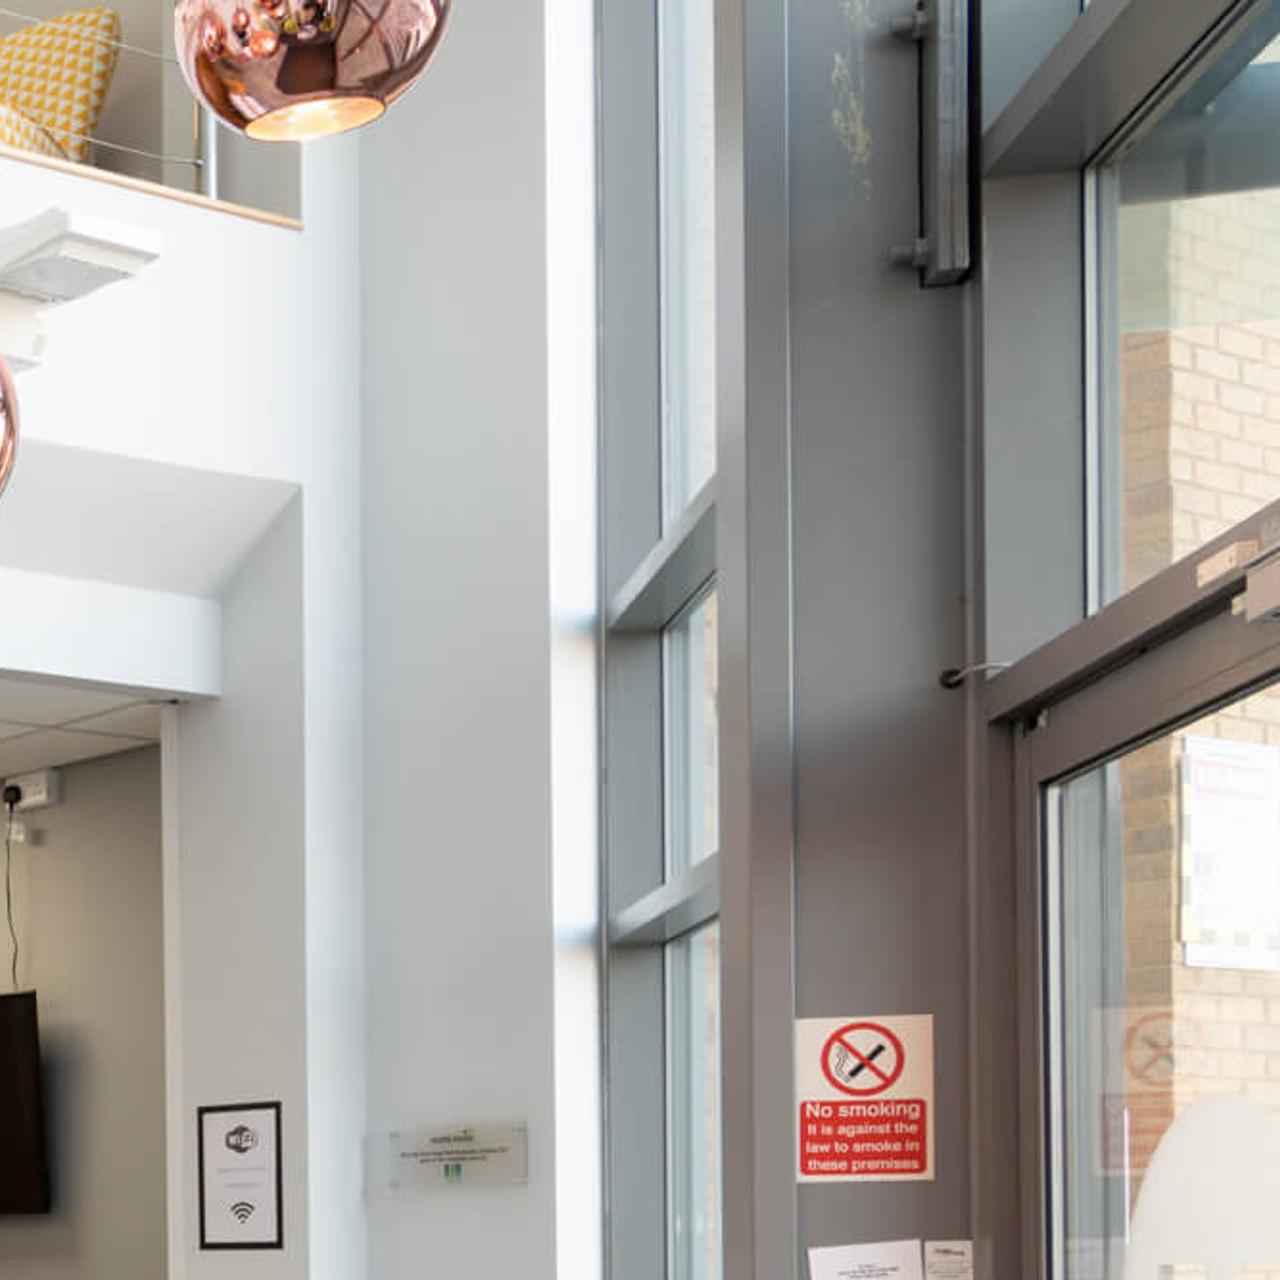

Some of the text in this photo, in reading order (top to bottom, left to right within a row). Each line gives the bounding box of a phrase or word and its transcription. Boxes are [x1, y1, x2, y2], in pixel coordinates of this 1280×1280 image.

[805, 1101, 921, 1119] No smoking
[837, 1123, 891, 1137] against
[893, 1122, 918, 1135] the
[806, 1140, 921, 1154] law to smoke in
[807, 1158, 920, 1173] these premises
